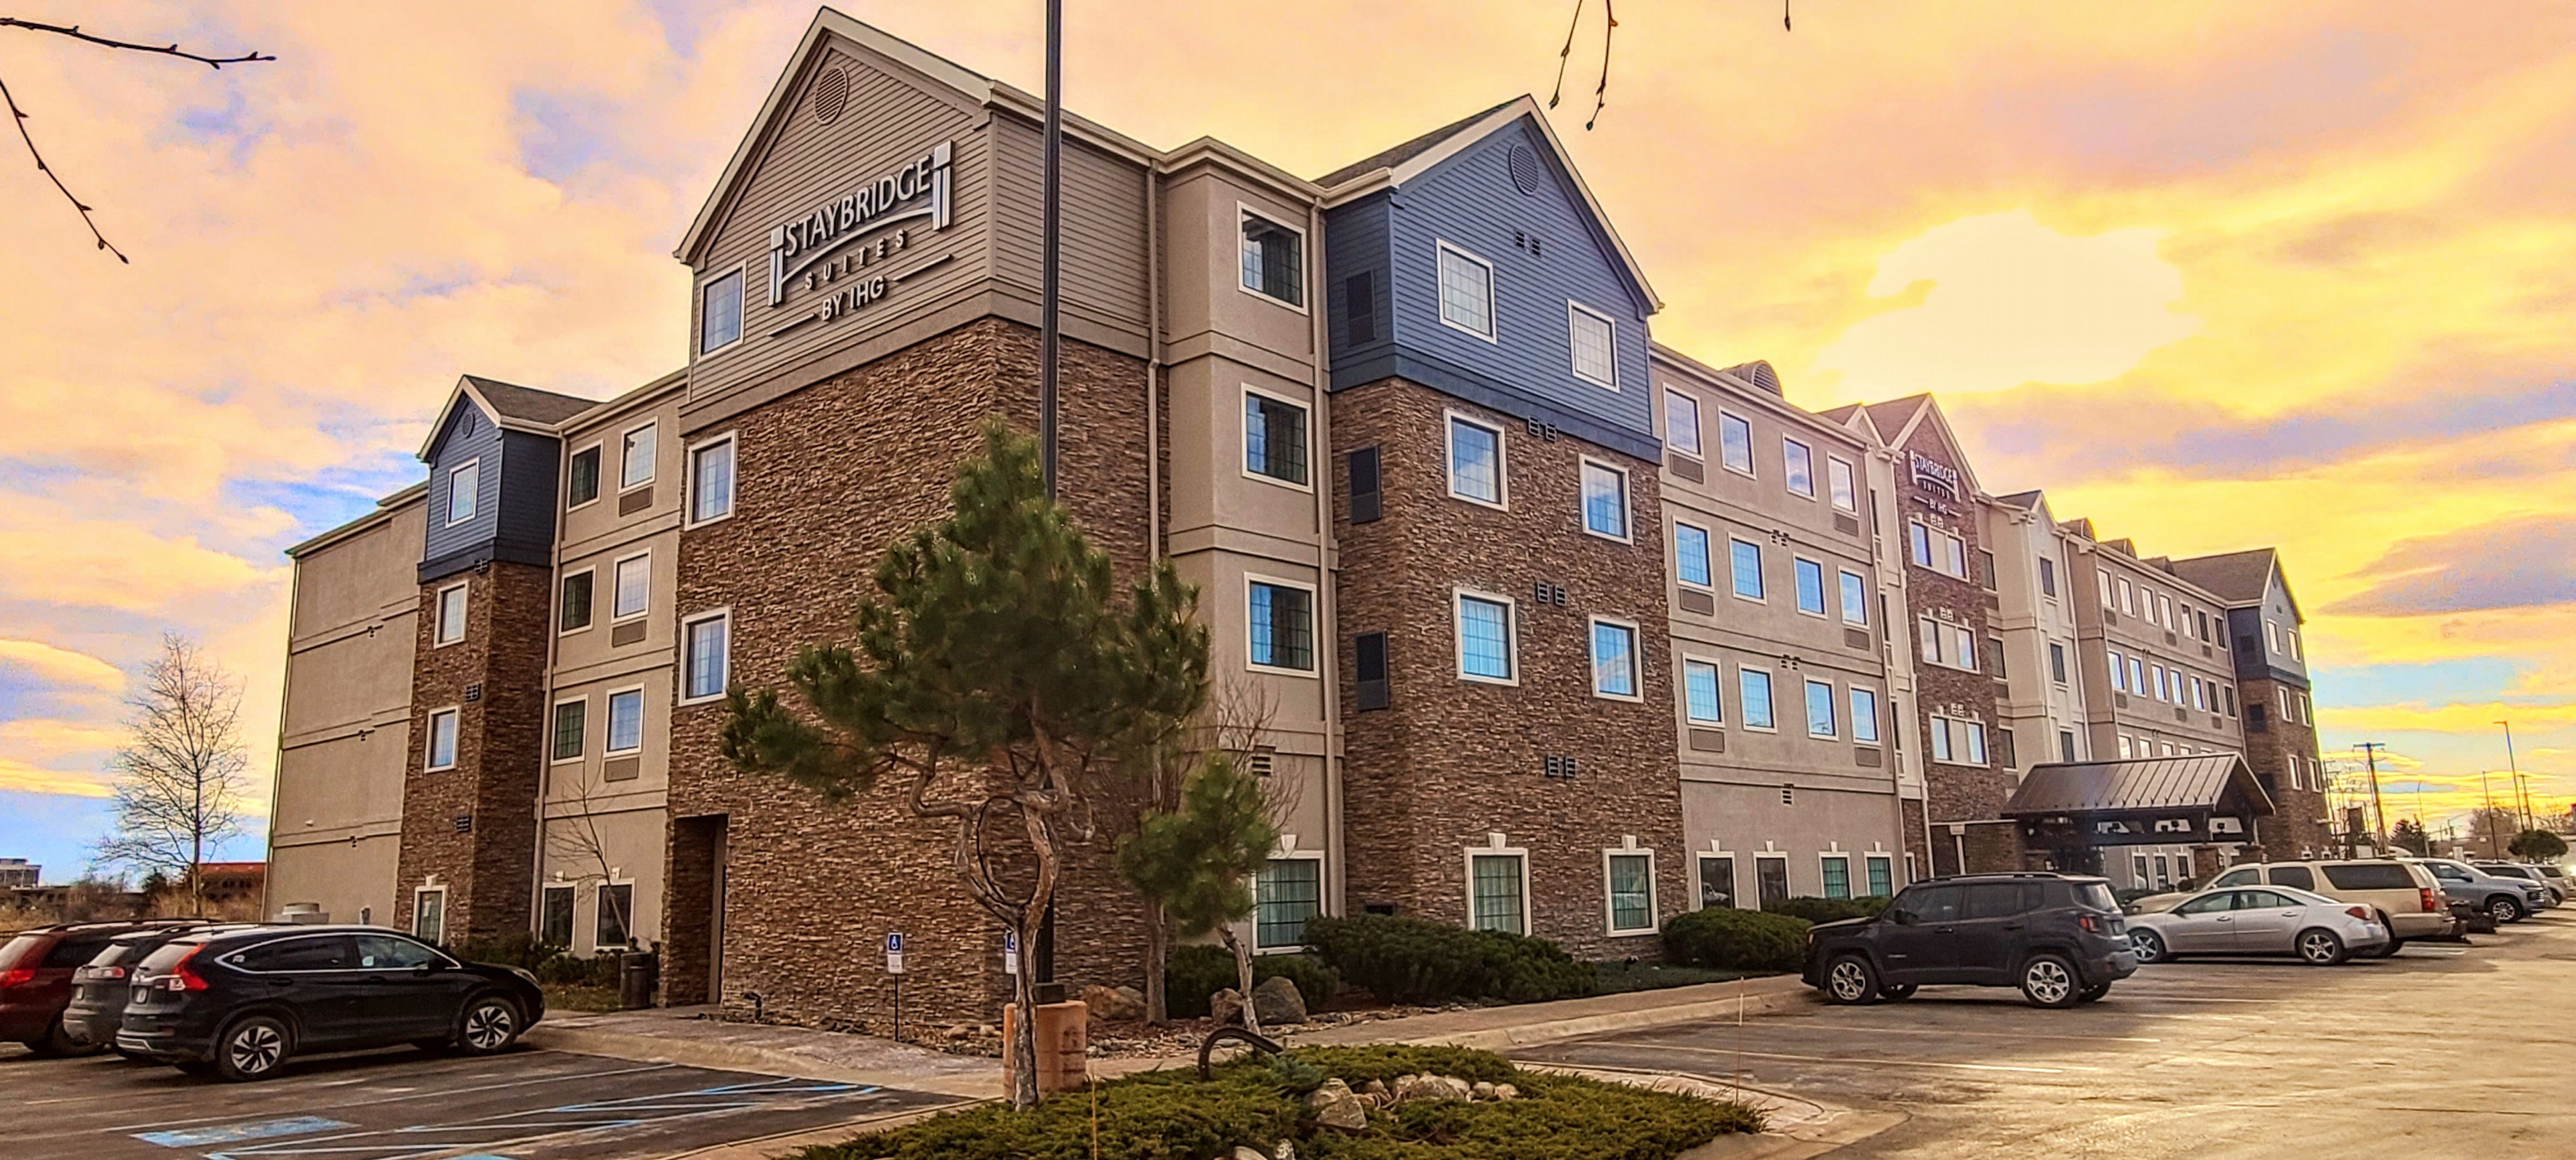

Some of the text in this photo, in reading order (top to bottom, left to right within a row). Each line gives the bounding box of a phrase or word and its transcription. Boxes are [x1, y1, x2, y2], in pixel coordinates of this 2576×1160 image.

[785, 155, 931, 257] STAYBRIDGE
[805, 229, 906, 290] SUITES
[822, 276, 885, 321] BY IHG
